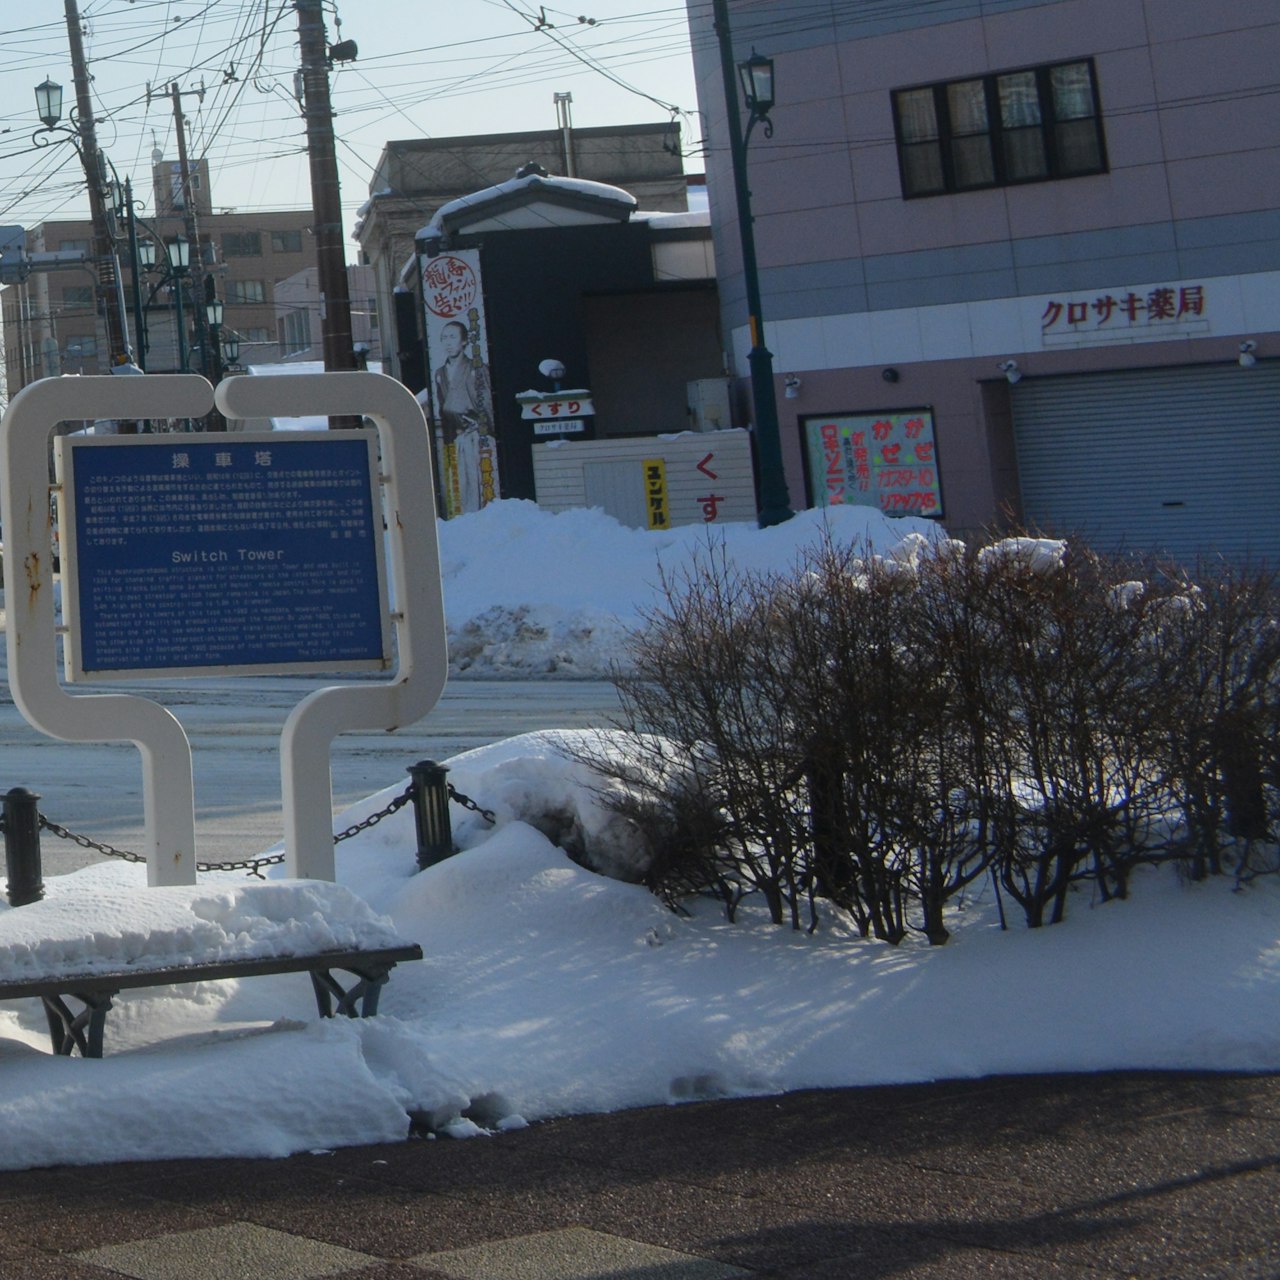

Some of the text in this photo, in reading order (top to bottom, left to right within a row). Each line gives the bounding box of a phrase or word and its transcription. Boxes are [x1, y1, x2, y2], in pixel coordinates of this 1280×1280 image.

[1041, 285, 1204, 329] クロサキ薬局
[531, 401, 581, 416] くすり
[170, 450, 273, 469] 操車塔
[647, 465, 667, 526] ユンケル
[171, 547, 284, 563] Switch Tower
